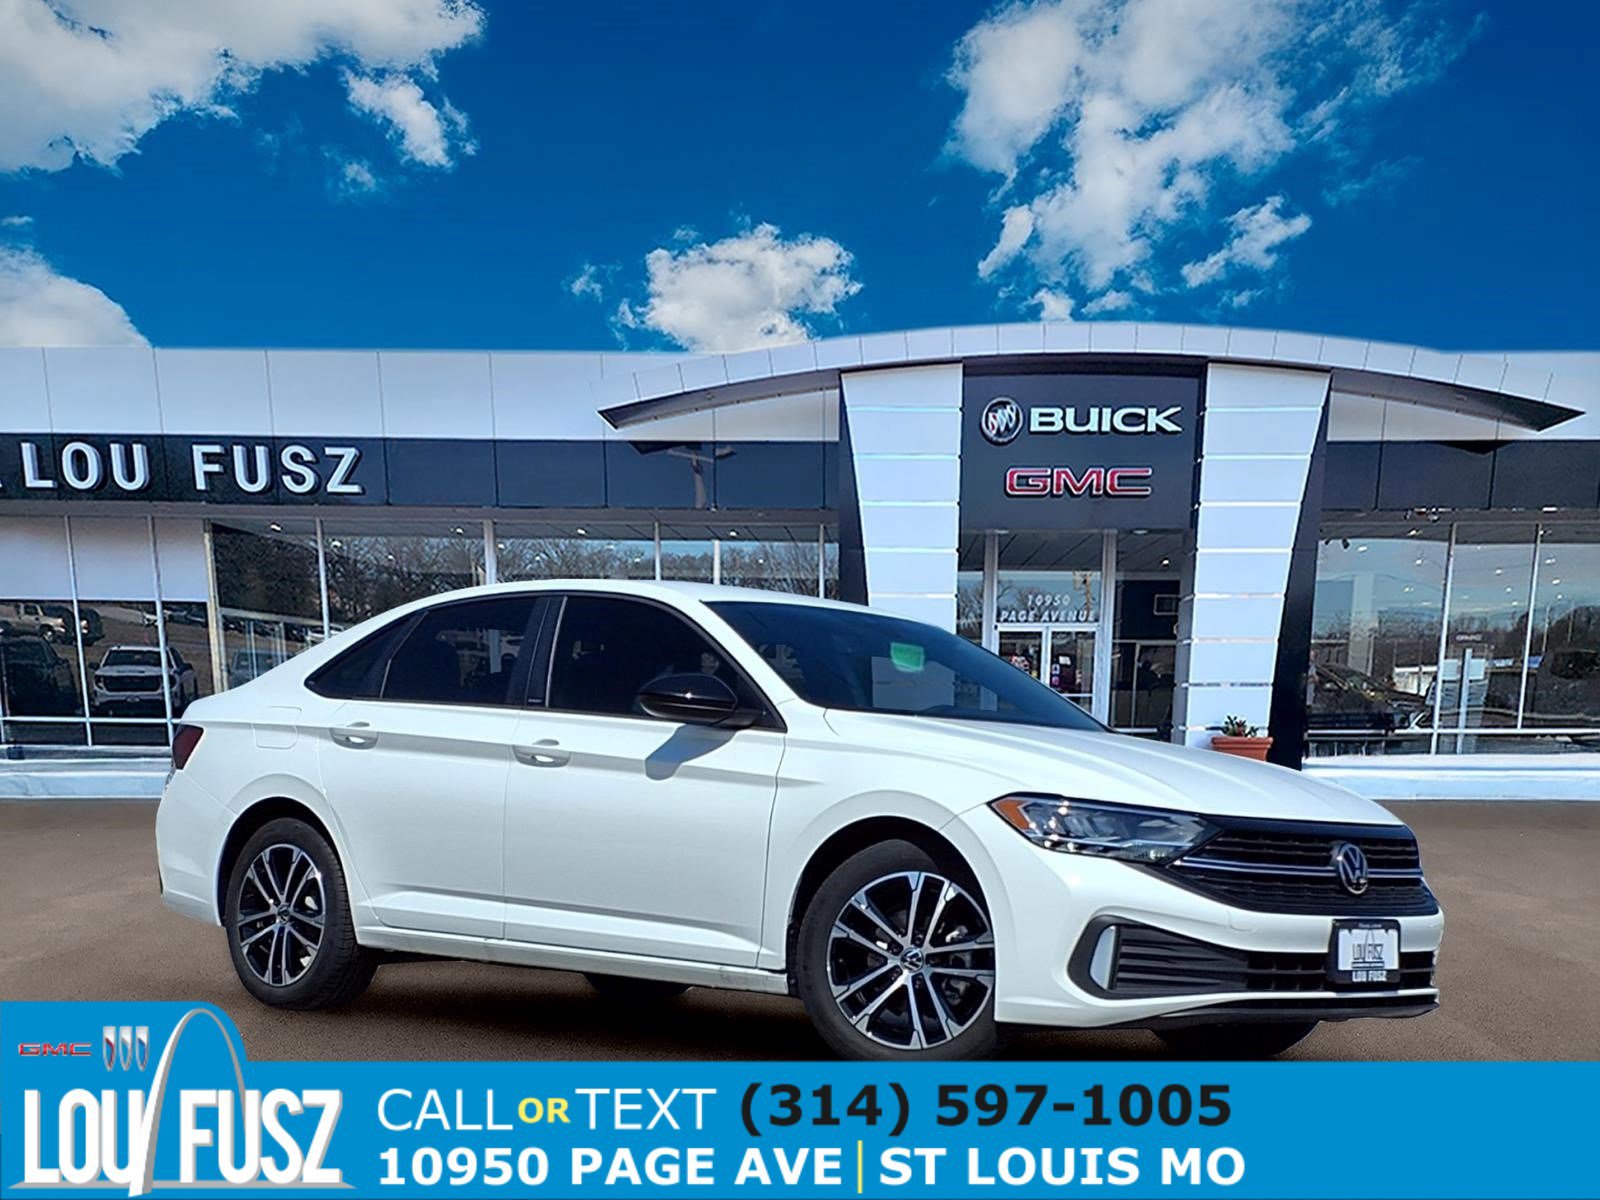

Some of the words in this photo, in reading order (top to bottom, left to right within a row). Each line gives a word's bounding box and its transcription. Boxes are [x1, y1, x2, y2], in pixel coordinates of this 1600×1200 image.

[1029, 406, 1183, 433] BUICK
[20, 441, 152, 491] LOU
[192, 443, 364, 495] FUSZ
[1006, 467, 1153, 496] GMC
[1028, 594, 1071, 606] 10950
[1001, 610, 1037, 622] PAGE
[1041, 609, 1096, 622] AVENUE
